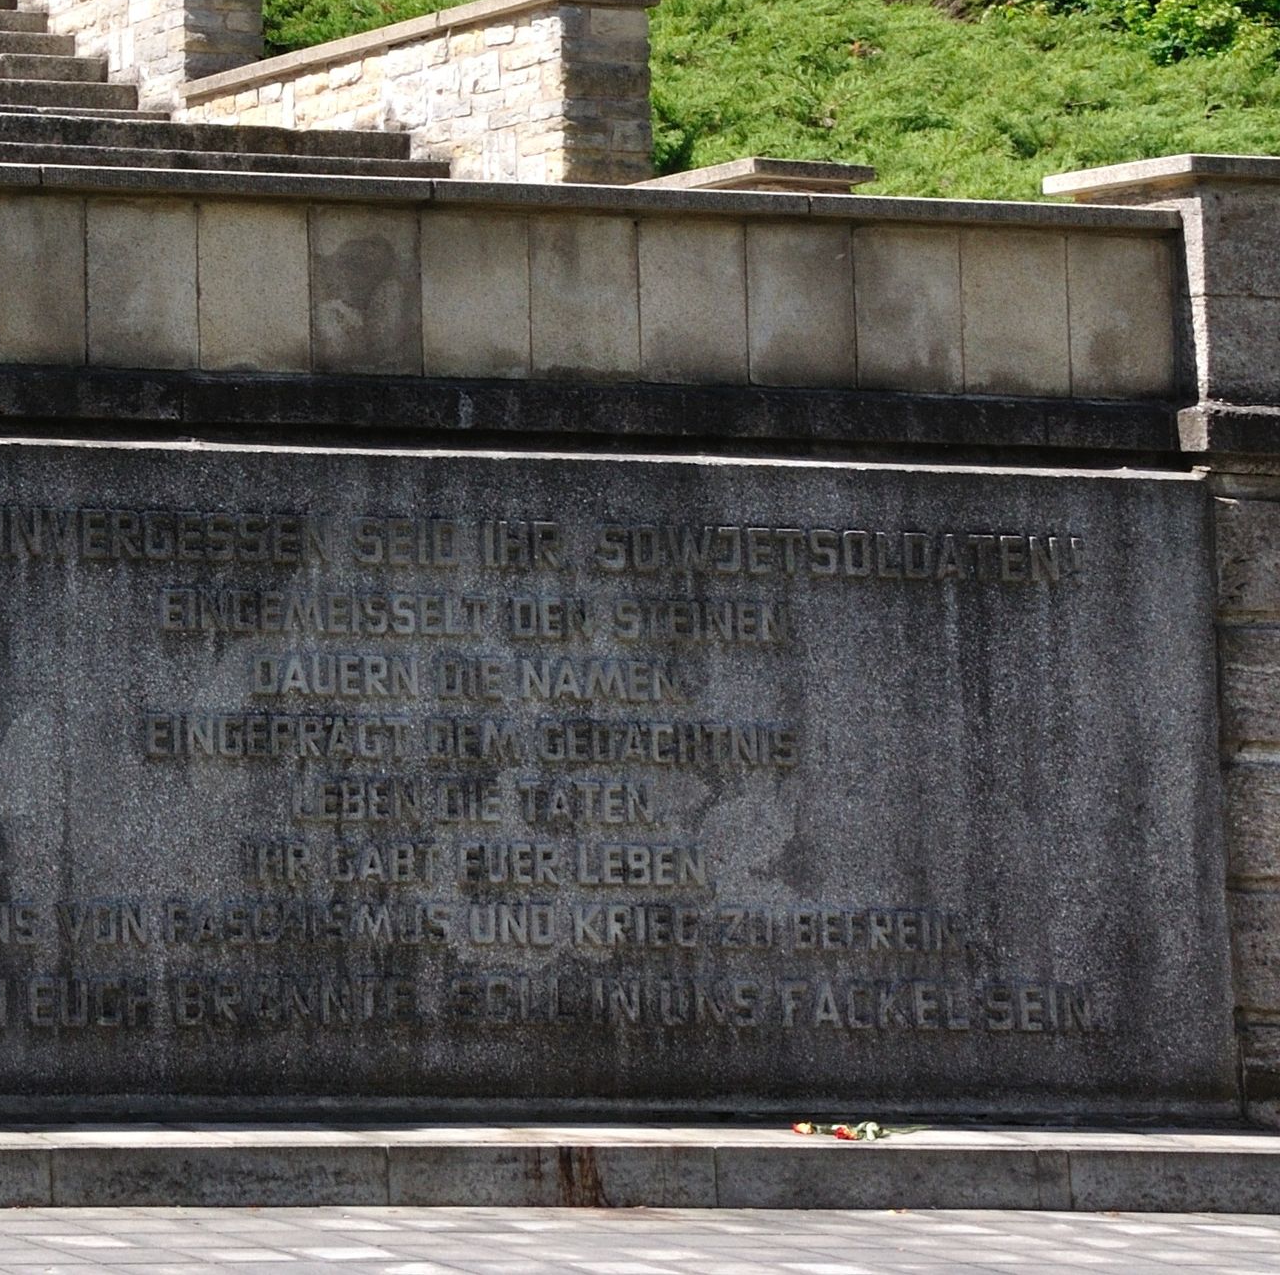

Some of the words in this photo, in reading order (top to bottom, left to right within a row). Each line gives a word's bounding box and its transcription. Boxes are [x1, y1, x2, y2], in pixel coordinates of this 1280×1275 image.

[352, 514, 460, 566] SEID
[159, 588, 486, 636] EINGEMEISSELT
[513, 595, 594, 637] DEN
[252, 653, 420, 696] DAUERN
[441, 656, 505, 699] DIE
[145, 713, 409, 759] EINGEPRÄGT
[430, 716, 523, 763] DEM
[540, 721, 801, 766] GEDÄCHTNIS
[292, 775, 421, 821] LEBEN
[441, 778, 503, 822] DIE
[245, 838, 312, 883] IHR
[330, 839, 440, 883] GABT
[456, 842, 560, 886] EUER
[54, 900, 150, 945] VON
[468, 902, 556, 946] UND
[573, 903, 700, 947] KRIEG
[718, 906, 774, 948] ZU
[28, 977, 160, 1026] EUCH
[592, 976, 640, 1024] IN
[658, 978, 760, 1026] UNS
[781, 979, 970, 1030] FACKEL
